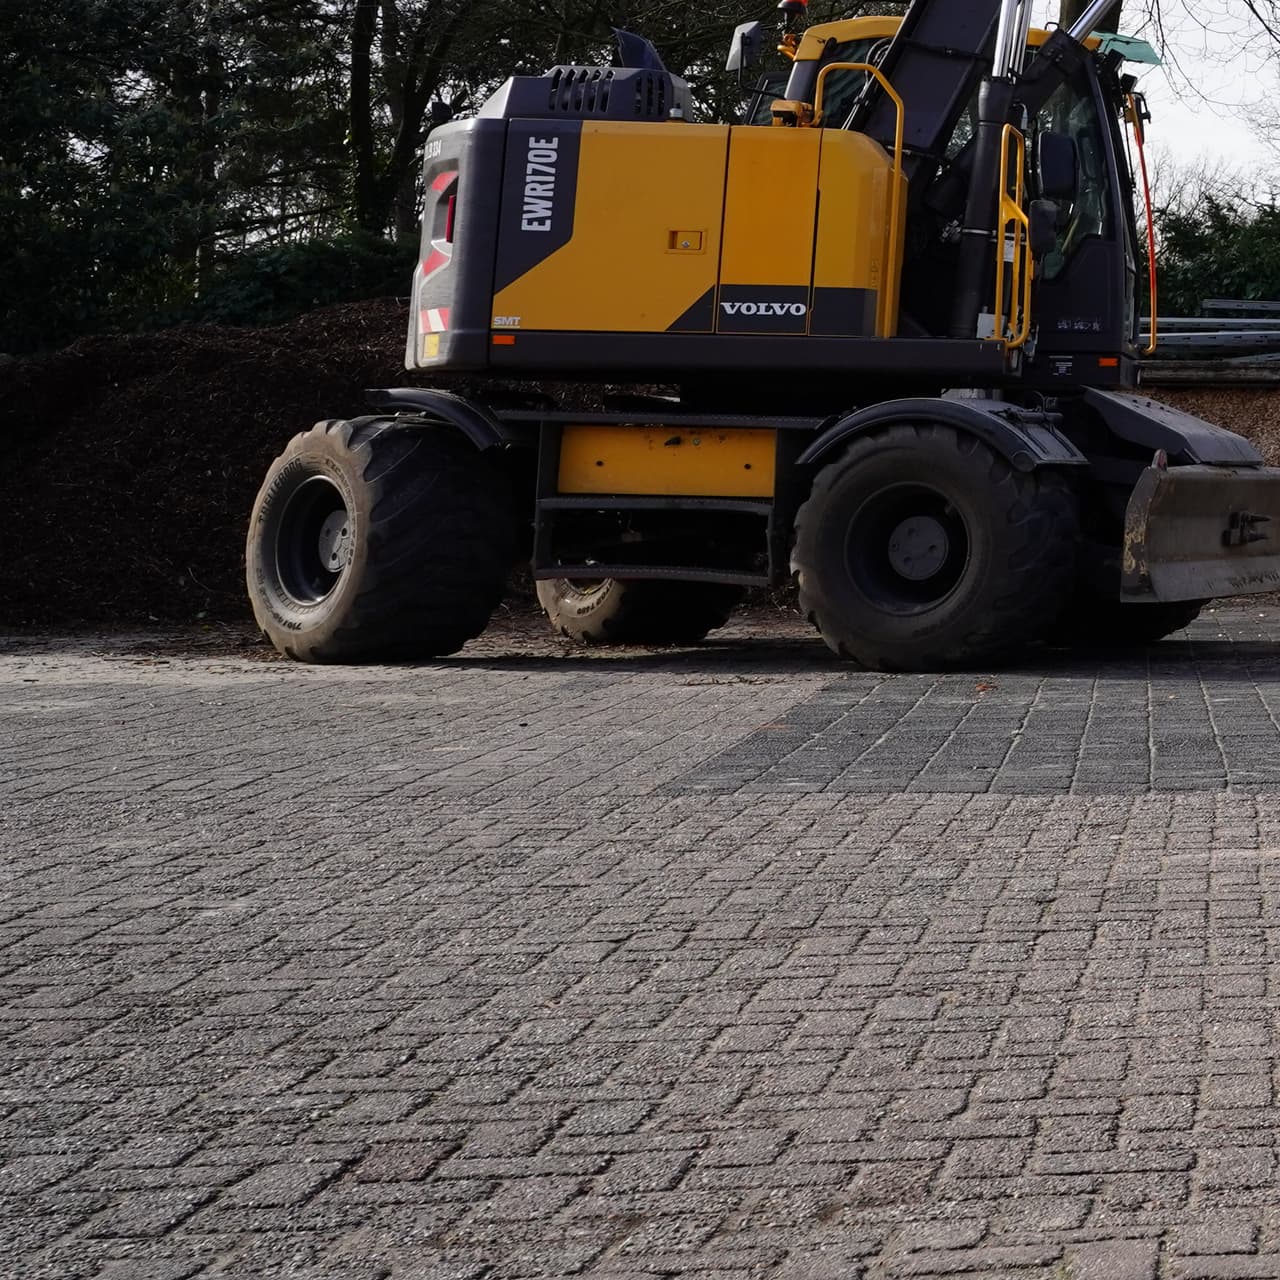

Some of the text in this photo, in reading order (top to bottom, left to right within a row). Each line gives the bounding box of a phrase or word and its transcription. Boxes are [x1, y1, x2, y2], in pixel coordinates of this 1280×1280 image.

[521, 136, 559, 231] EWR170E
[720, 302, 807, 316] VOLVO
[494, 316, 520, 325] SMT
